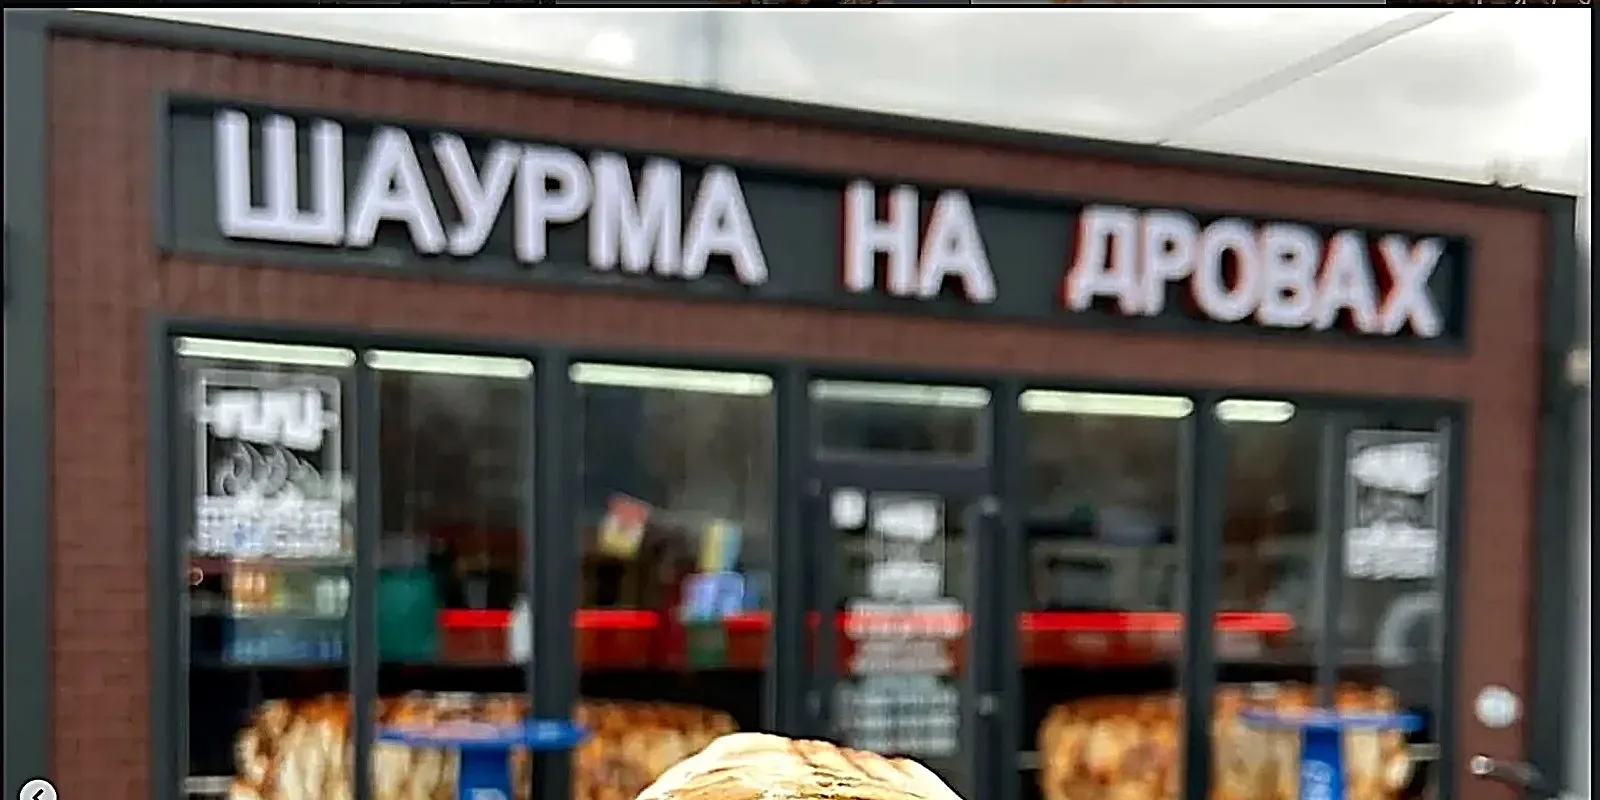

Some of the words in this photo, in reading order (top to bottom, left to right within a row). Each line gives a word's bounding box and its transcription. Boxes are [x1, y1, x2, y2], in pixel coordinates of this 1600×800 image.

[214, 109, 769, 285] ШАУРМА
[843, 180, 996, 303] НА
[1064, 204, 1444, 338] ДРОВАХ
